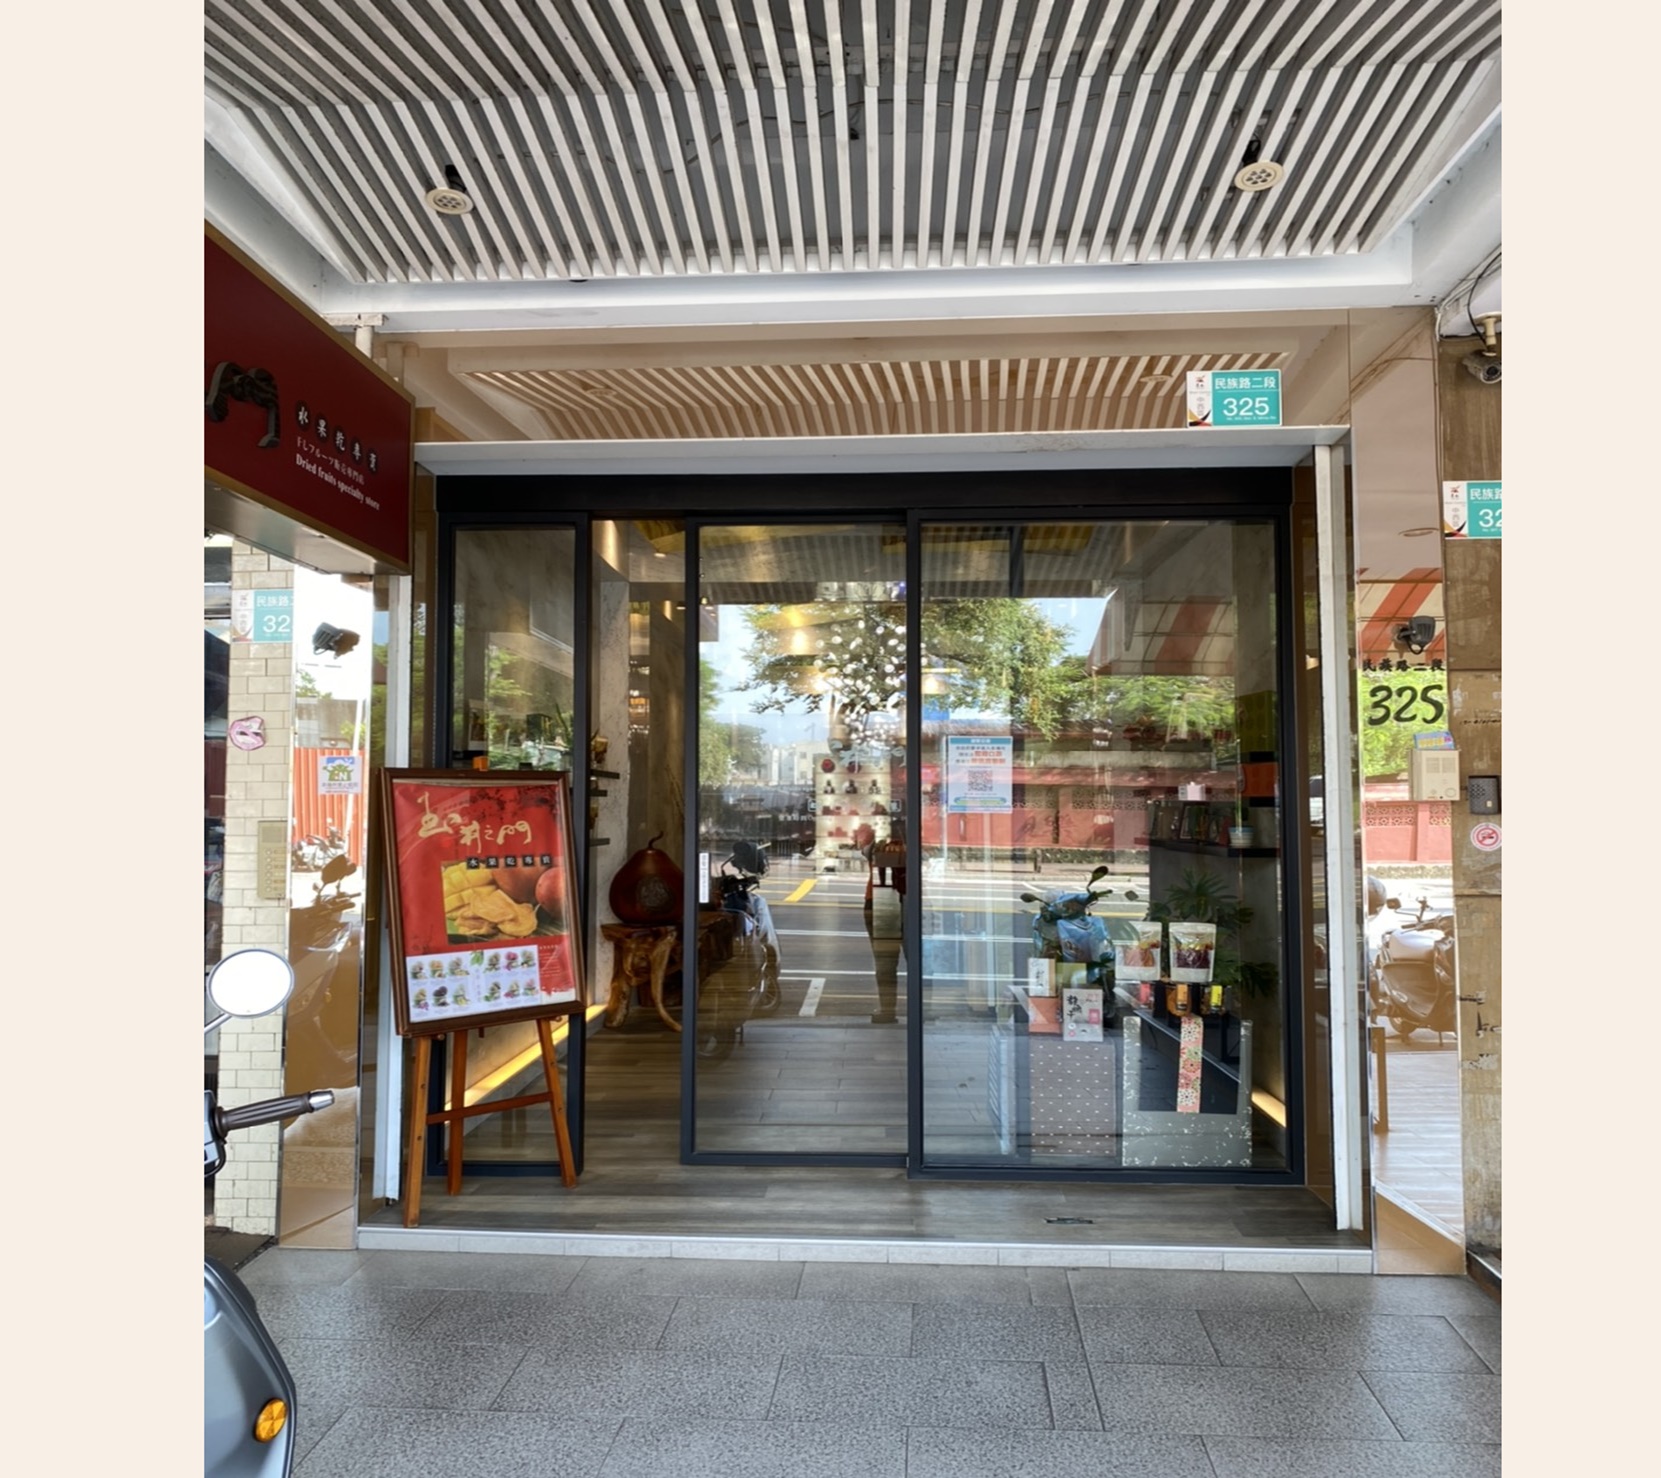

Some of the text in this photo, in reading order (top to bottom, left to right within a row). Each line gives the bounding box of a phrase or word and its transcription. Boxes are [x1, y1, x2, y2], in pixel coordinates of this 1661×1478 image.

[1215, 376, 1276, 389] 民族路二段
[1223, 397, 1270, 417] 325
[296, 453, 380, 511] Dried fruits specialty store
[263, 614, 291, 633] 32
[1363, 658, 1445, 671] 民族路二段
[1368, 685, 1444, 726] 325
